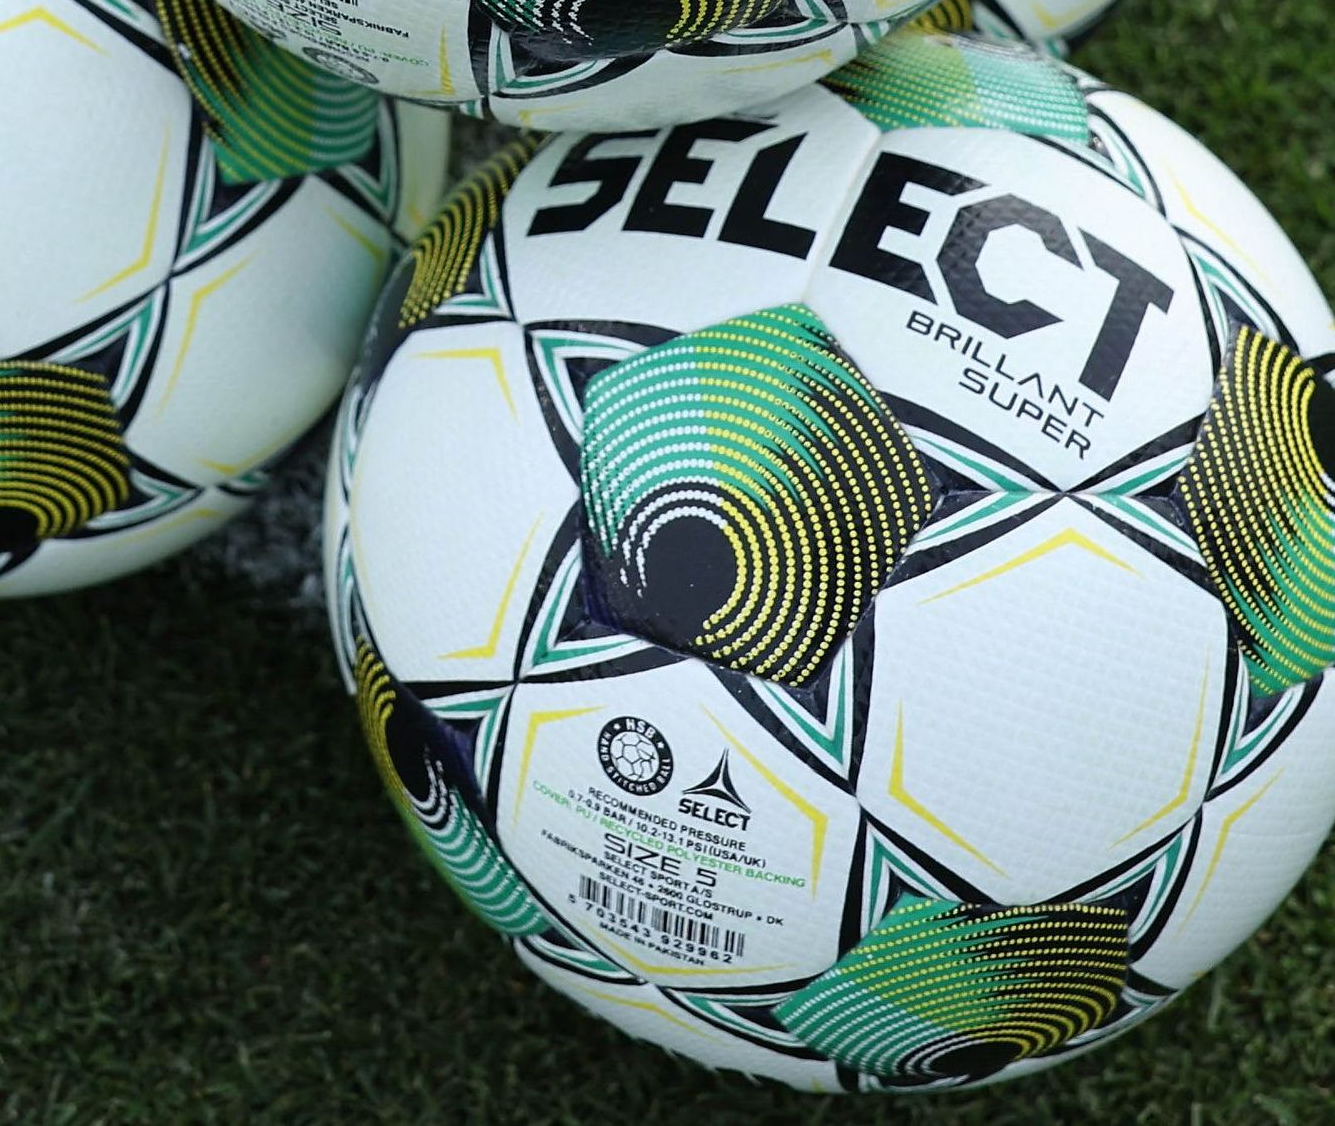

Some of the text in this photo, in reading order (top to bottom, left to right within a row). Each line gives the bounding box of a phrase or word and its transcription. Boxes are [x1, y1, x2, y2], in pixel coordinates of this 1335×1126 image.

[527, 116, 1175, 402] SELECT
[905, 308, 1105, 427] BRILLANT
[957, 362, 1093, 459] SUPER
[625, 717, 657, 739] HSB
[588, 786, 747, 852] RECOMMENDED PRESSURE
[603, 805, 627, 825] BAR
[636, 821, 684, 846] 10.2-13.1
[678, 797, 751, 831] SELECT
[599, 818, 664, 850] RECYCLED
[667, 844, 742, 874] POLYESTER
[746, 868, 806, 888] BACKING
[604, 832, 718, 888] SIZE 5
[604, 851, 713, 899] SELECT SPORT A/S
[599, 871, 713, 920] SELECT-SPORT.COM
[686, 894, 753, 919] GLOSTRUP
[766, 915, 784, 926] DK
